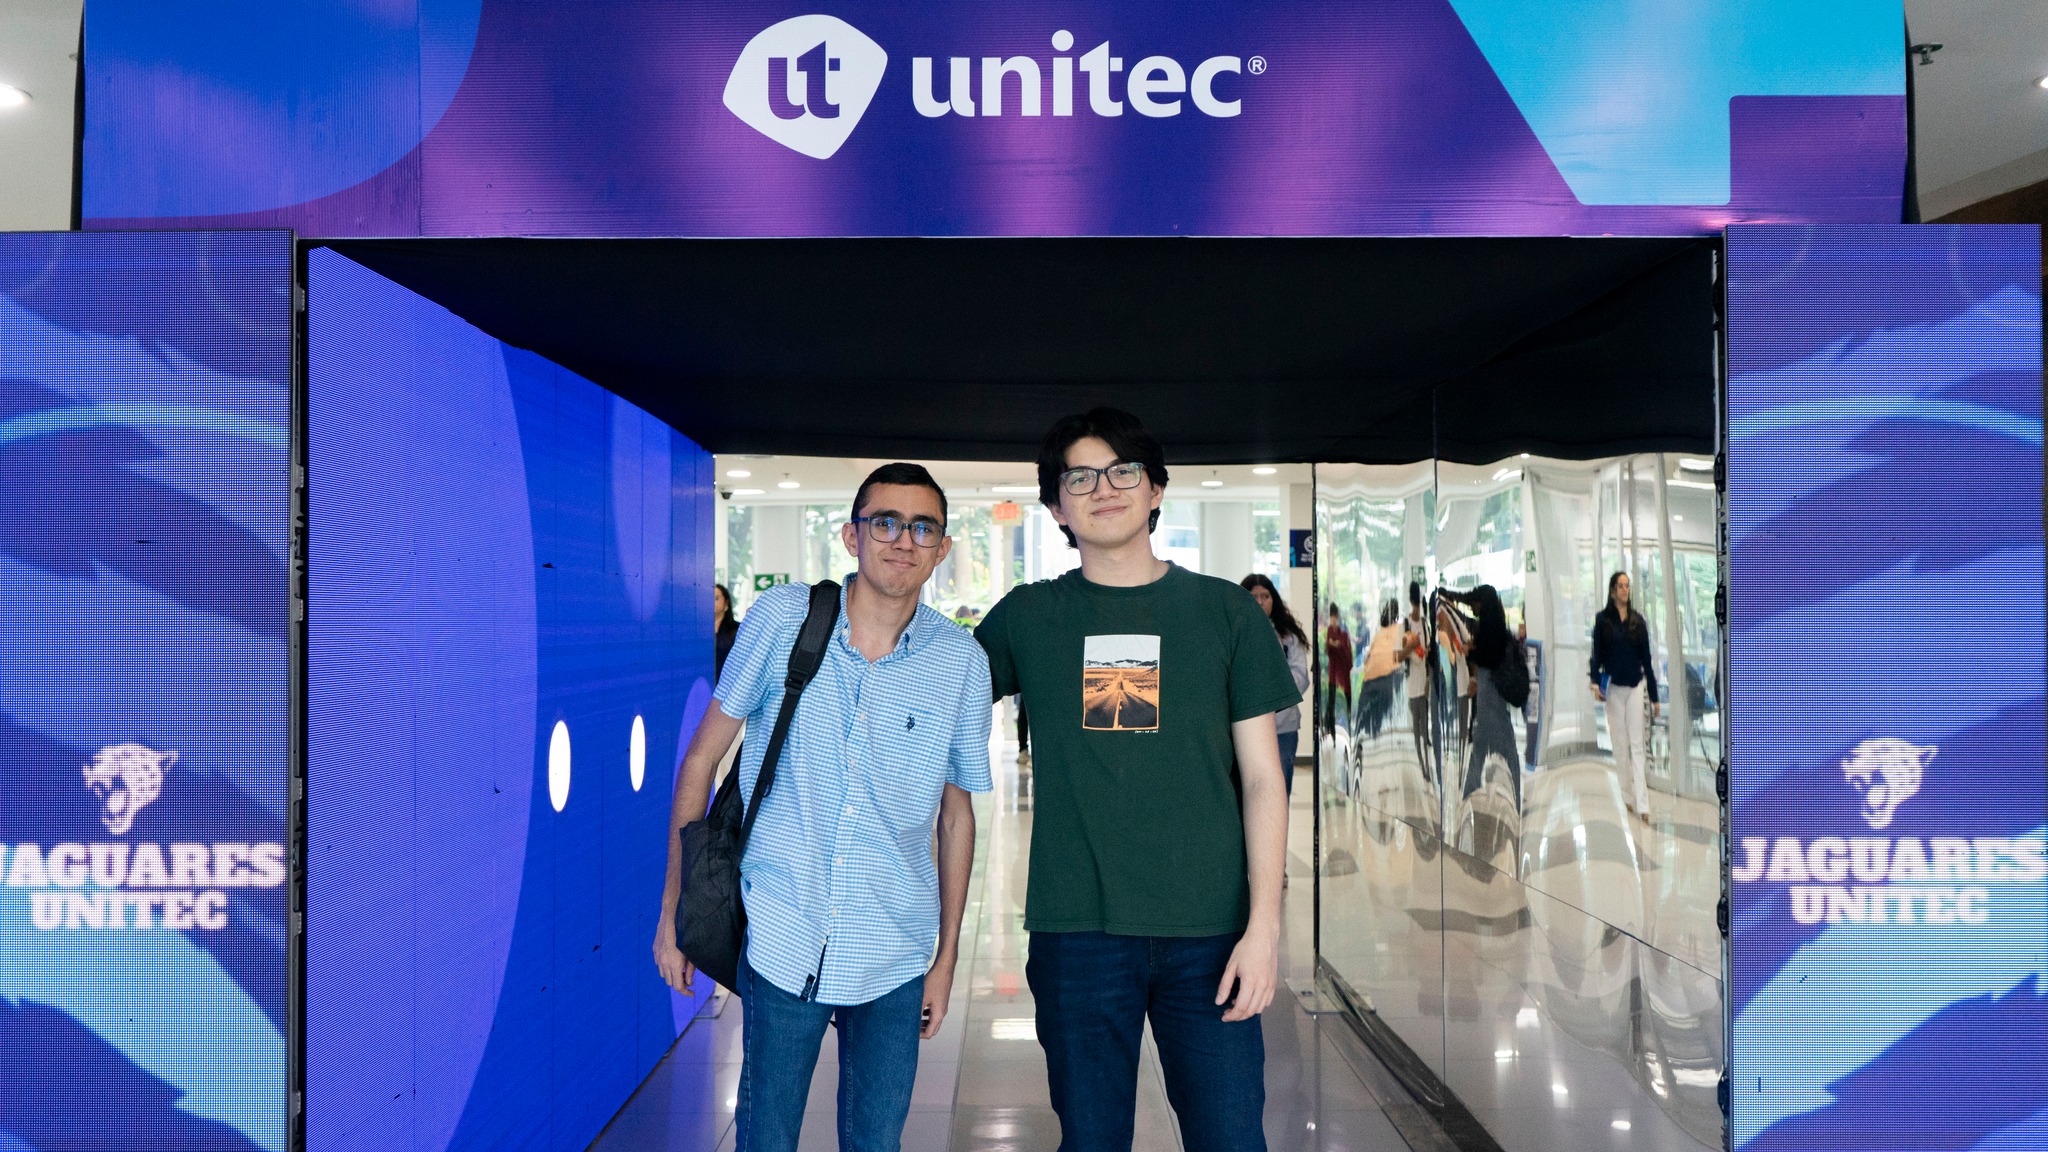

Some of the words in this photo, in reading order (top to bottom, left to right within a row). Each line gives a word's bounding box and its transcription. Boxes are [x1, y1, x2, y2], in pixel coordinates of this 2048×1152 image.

[0, 843, 286, 887] AGUARES
[1732, 837, 2046, 881] JAGUARES
[31, 891, 228, 929] UNITEC
[1790, 887, 1989, 924] UNITEC
